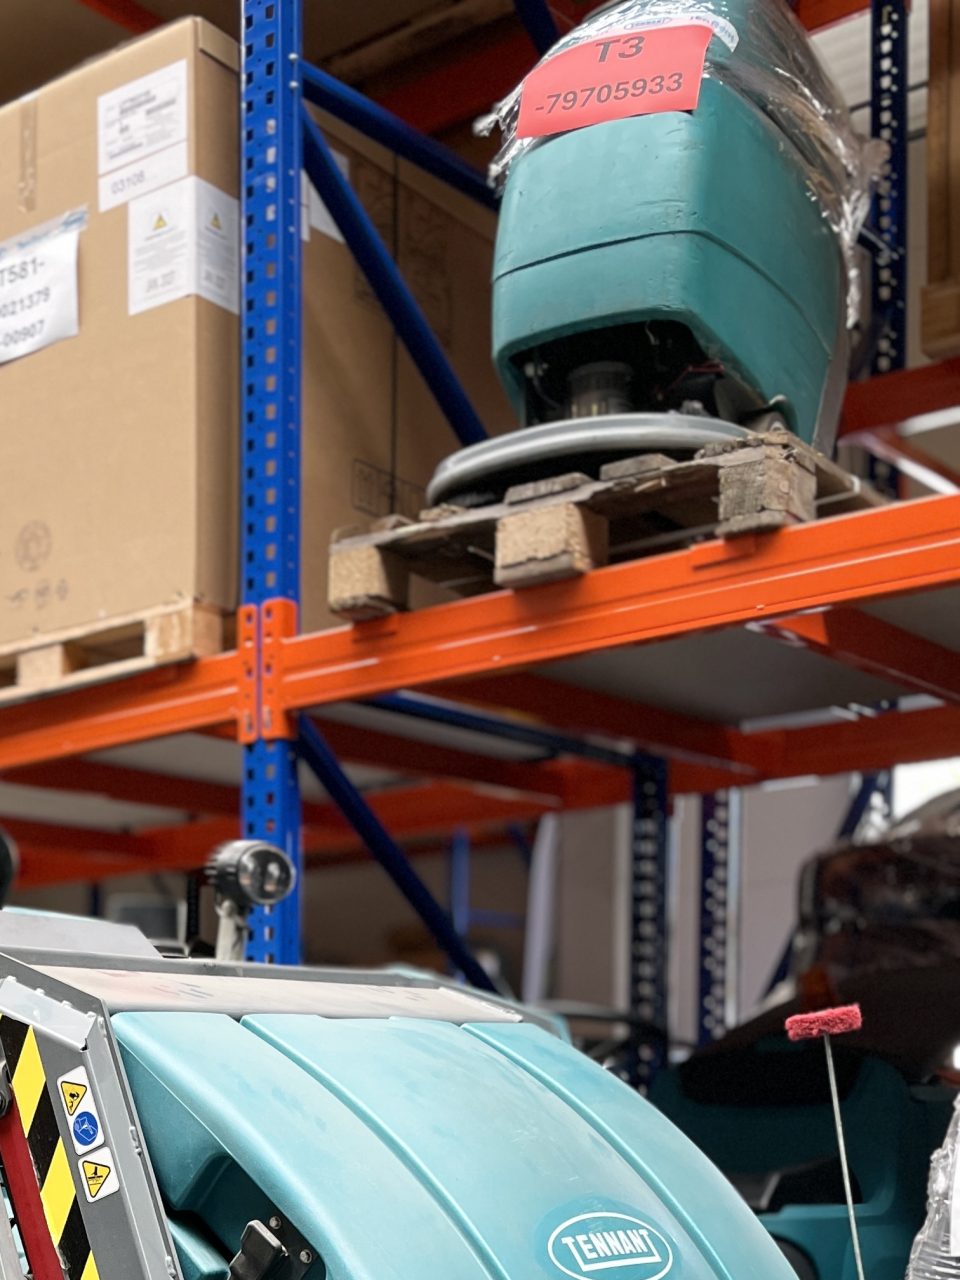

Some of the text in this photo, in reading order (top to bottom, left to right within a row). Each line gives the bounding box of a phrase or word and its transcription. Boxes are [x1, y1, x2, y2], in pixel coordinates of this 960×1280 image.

[595, 36, 645, 63] T3
[535, 72, 684, 115] -79705933
[561, 1229, 661, 1271] TENNANT
